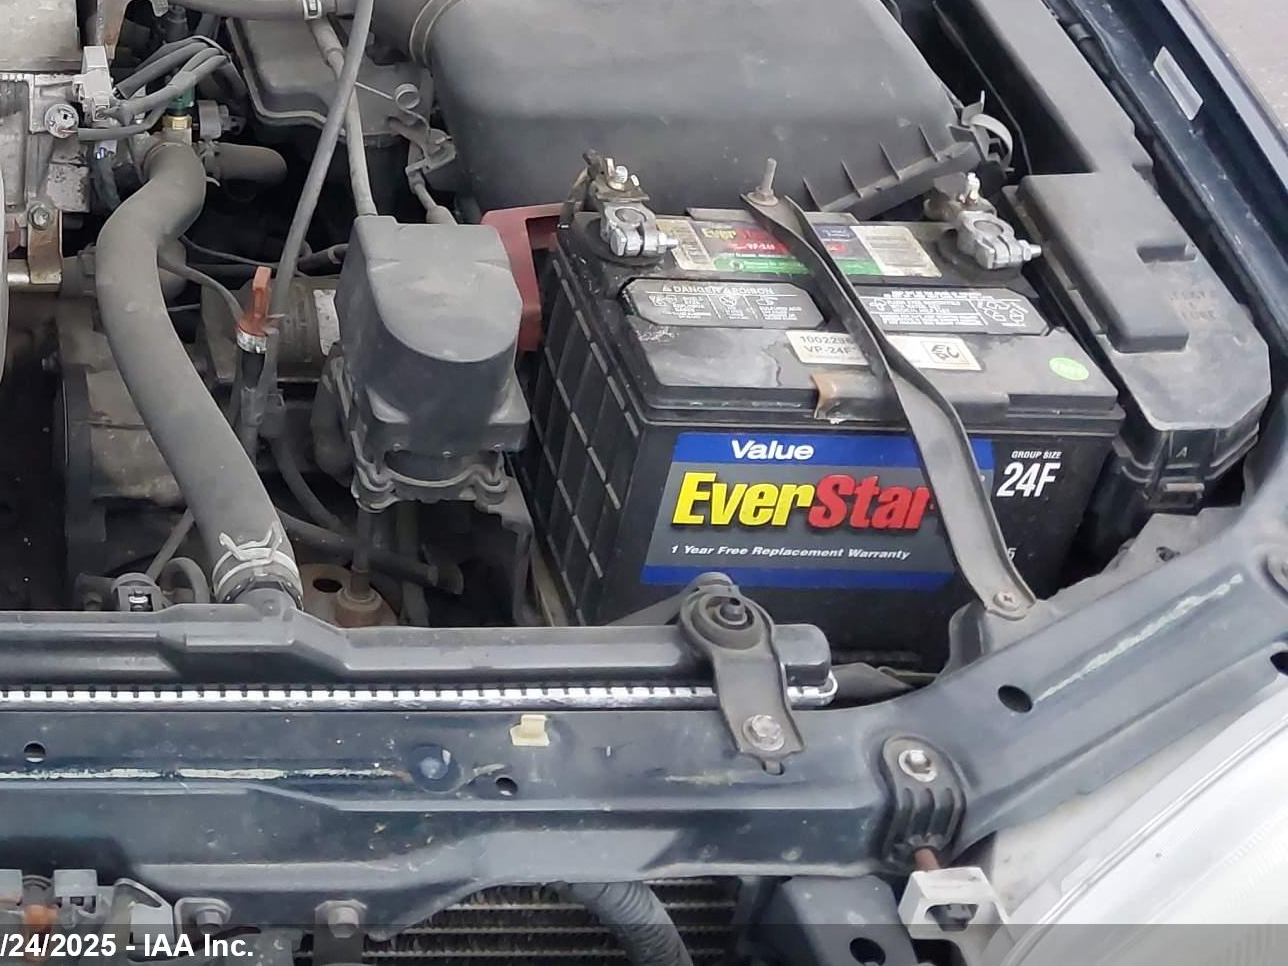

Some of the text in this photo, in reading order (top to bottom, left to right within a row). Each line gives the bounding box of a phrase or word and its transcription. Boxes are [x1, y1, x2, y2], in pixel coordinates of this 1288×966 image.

[731, 439, 814, 460] Value
[1011, 450, 1062, 459] GROUP SIZE
[996, 461, 1061, 497] 24F
[671, 545, 911, 560] 1 Year Free Replacement Warranty
